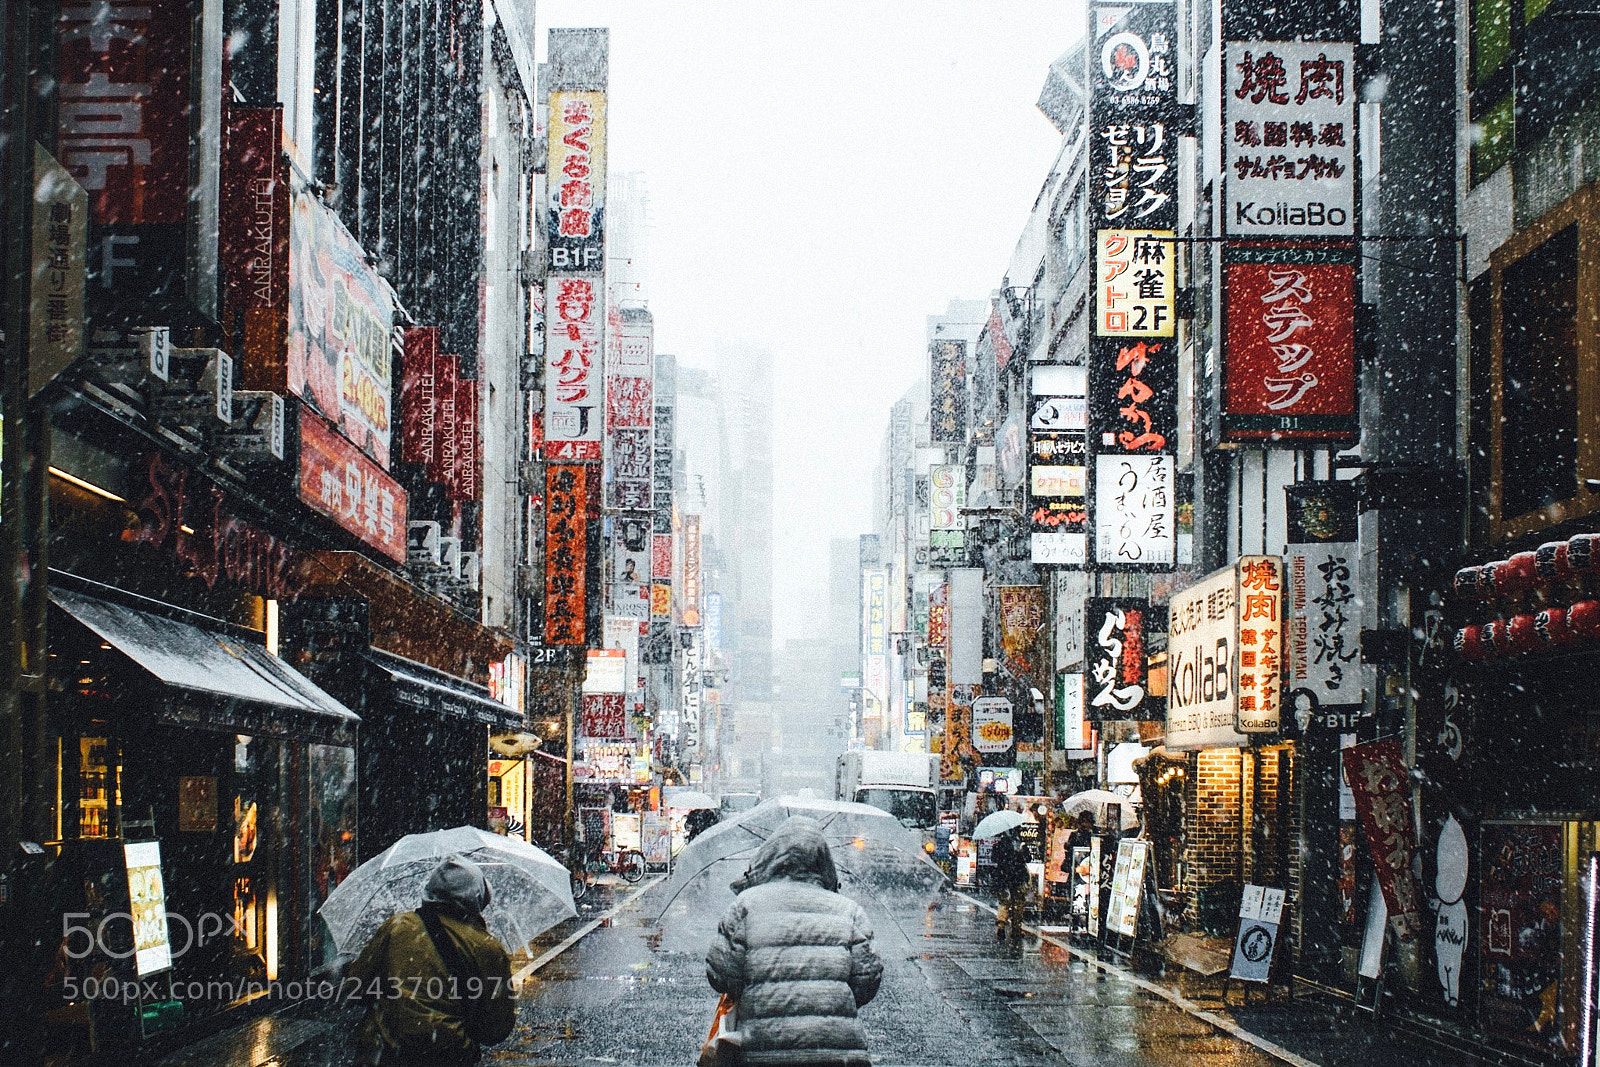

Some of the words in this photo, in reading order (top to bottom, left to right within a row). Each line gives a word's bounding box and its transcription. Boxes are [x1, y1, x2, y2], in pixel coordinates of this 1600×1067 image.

[1234, 50, 1344, 106] 焼肉
[1234, 120, 1346, 148] 韓国料理
[1233, 153, 1346, 181] サムギョプサル
[253, 177, 273, 304] ANRAKUTEI
[1236, 201, 1347, 226] KollaBo
[552, 248, 599, 267] B1F
[1104, 233, 1128, 332] クアトロ
[1132, 233, 1166, 299] 麻雀
[1132, 305, 1168, 331] 2F
[1261, 270, 1319, 411] ステップ
[421, 373, 434, 459] ANRAKUTEI
[442, 398, 455, 481] ANRAKUTEI
[1280, 416, 1300, 429] B1
[462, 421, 474, 496] ANRAKUTEI
[558, 444, 588, 459] 4F
[345, 459, 395, 545] 安楽亭
[1141, 456, 1169, 539] 居酒屋
[1241, 559, 1280, 622] 焼肉
[1312, 554, 1358, 691] お好み焼き
[534, 649, 557, 663] 2F
[1240, 628, 1257, 712] 韓国料理
[1259, 628, 1279, 712] サムギョプサル
[1240, 718, 1278, 729] KollaBo
[1326, 714, 1361, 729] B1F
